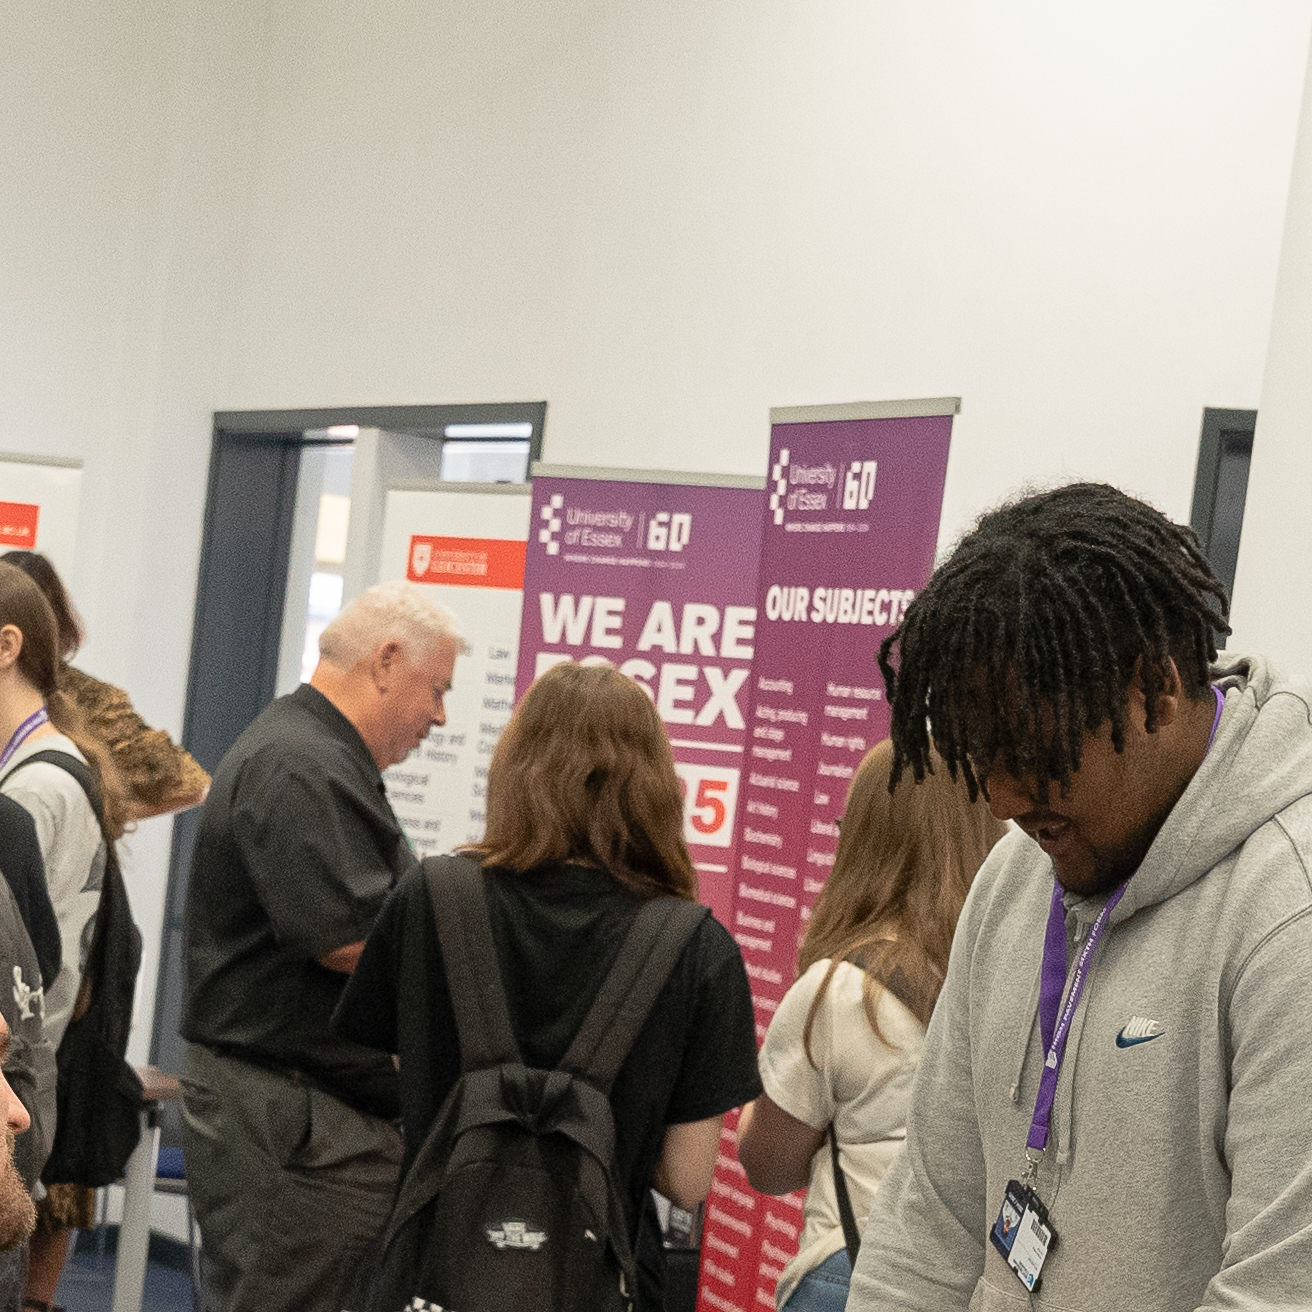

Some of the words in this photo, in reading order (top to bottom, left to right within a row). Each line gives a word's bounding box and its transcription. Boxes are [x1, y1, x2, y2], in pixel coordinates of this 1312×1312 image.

[566, 508, 634, 531] University
[580, 529, 624, 548] Essex
[765, 584, 810, 622] OUR
[539, 592, 626, 649] WE
[637, 600, 758, 660] ARE
[535, 652, 750, 730] SEX
[1063, 968, 1083, 1021] PAVEMENT
[1079, 937, 1094, 967] SIXTH
[1122, 1016, 1159, 1037] NIKE
